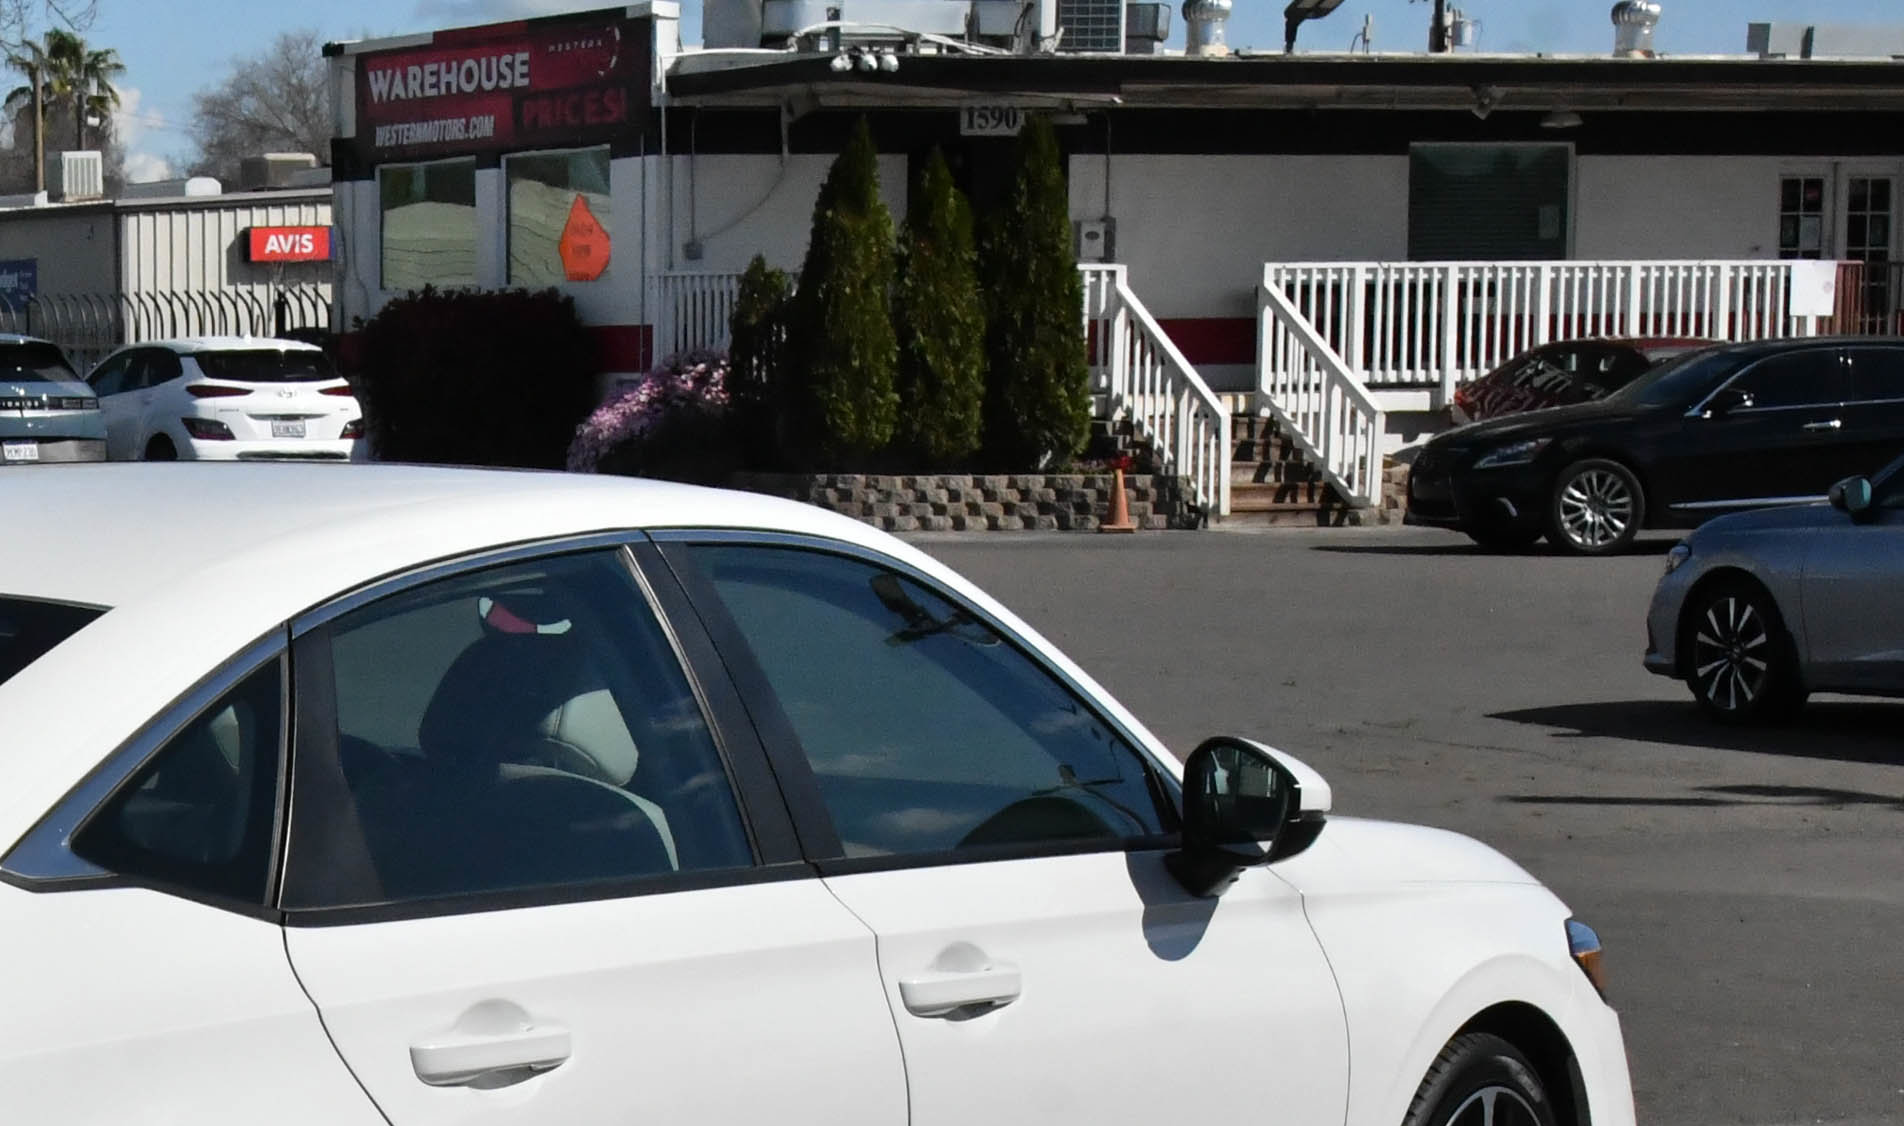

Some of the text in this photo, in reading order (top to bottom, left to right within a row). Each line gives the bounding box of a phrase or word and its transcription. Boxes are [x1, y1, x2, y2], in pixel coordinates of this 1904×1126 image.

[368, 52, 530, 104] WAREHOUSE
[375, 115, 495, 147] WESTERNMOTORS.COM
[967, 106, 1018, 129] 1590
[265, 234, 314, 254] AVIS
